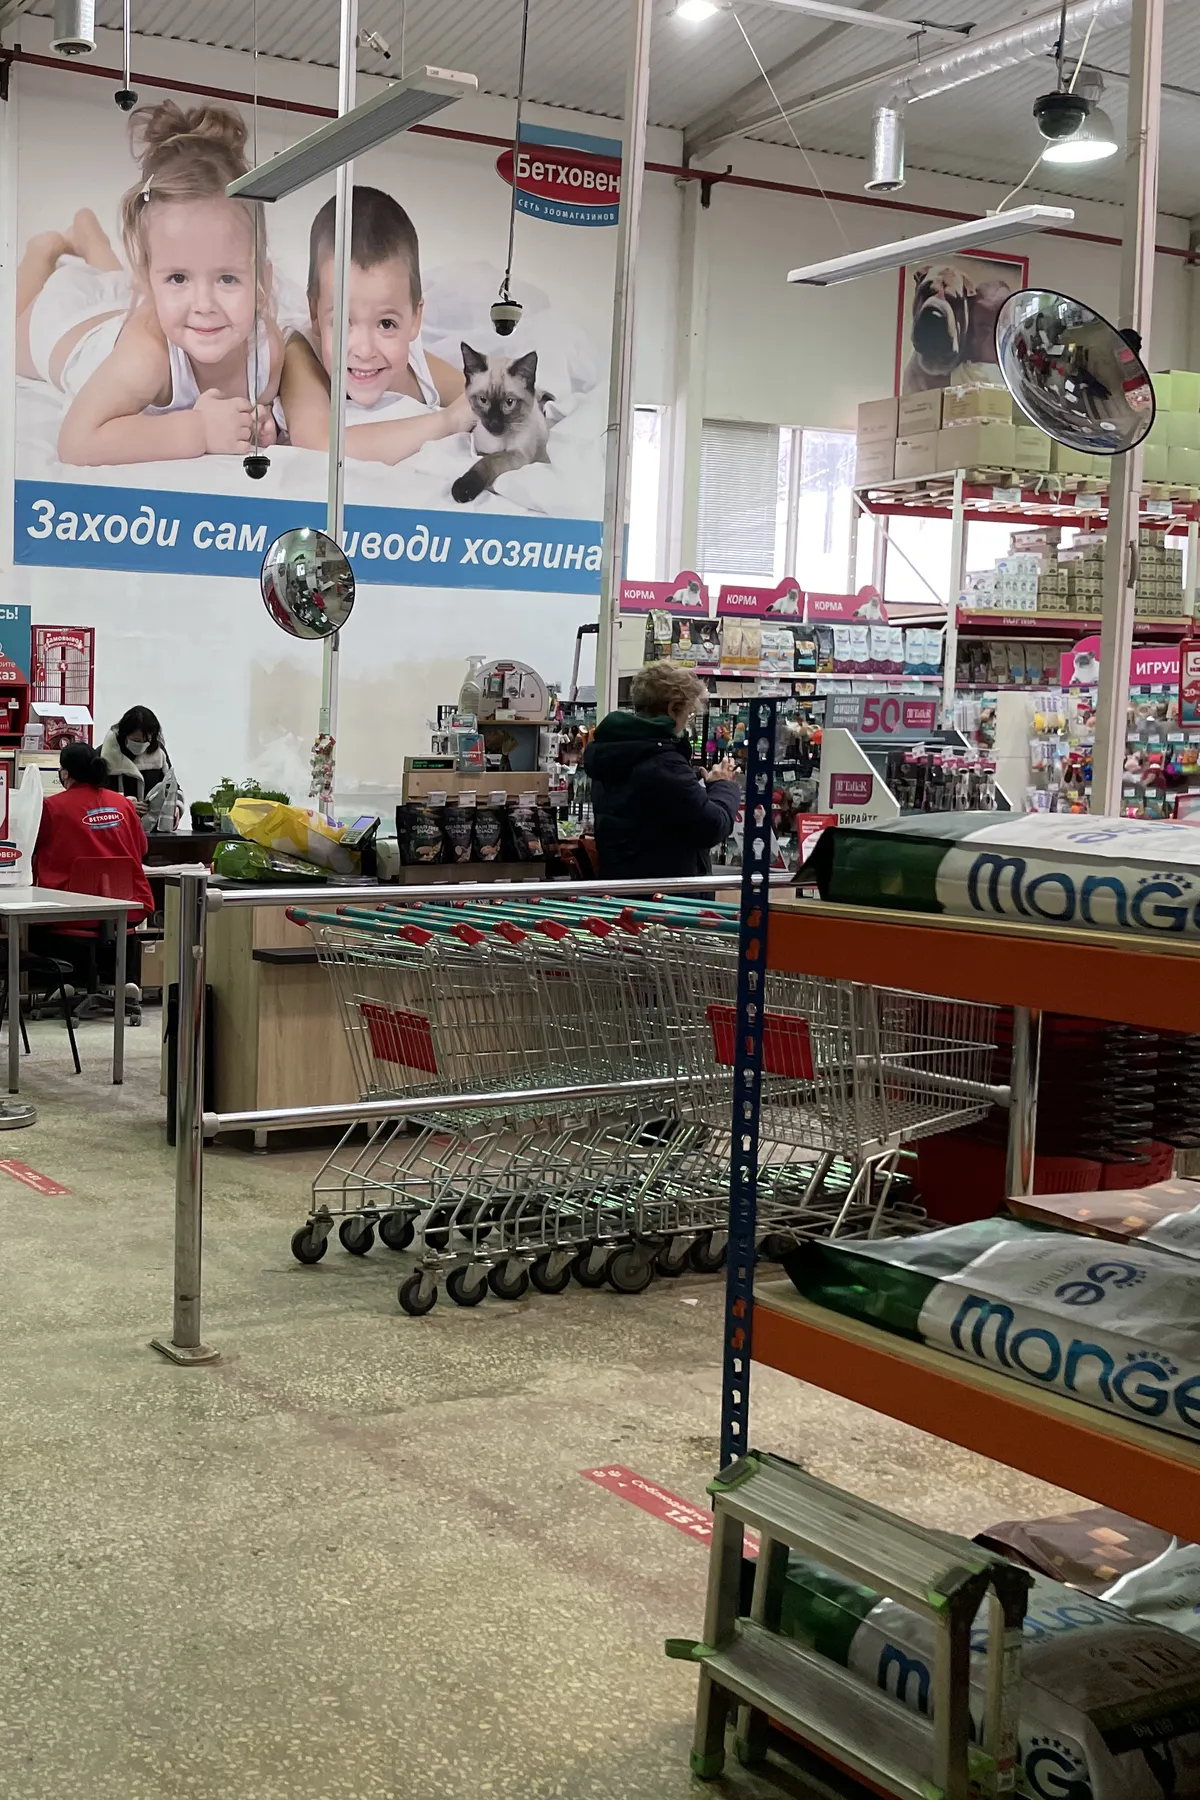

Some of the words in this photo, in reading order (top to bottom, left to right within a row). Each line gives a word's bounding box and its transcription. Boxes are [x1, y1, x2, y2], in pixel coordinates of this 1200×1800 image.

[516, 153, 621, 193] Бетховен
[518, 198, 541, 212] СЕТЬ
[543, 206, 616, 221] ЗООМАГАЗИНОВ
[26, 499, 181, 548] Заходи
[459, 537, 604, 572] хозяина
[624, 588, 656, 601] КОРМА
[726, 593, 758, 607] КОРМА
[814, 600, 844, 612] КОРМА
[1136, 661, 1180, 676] ИГРУШ
[839, 812, 879, 825] БИРАЙТ
